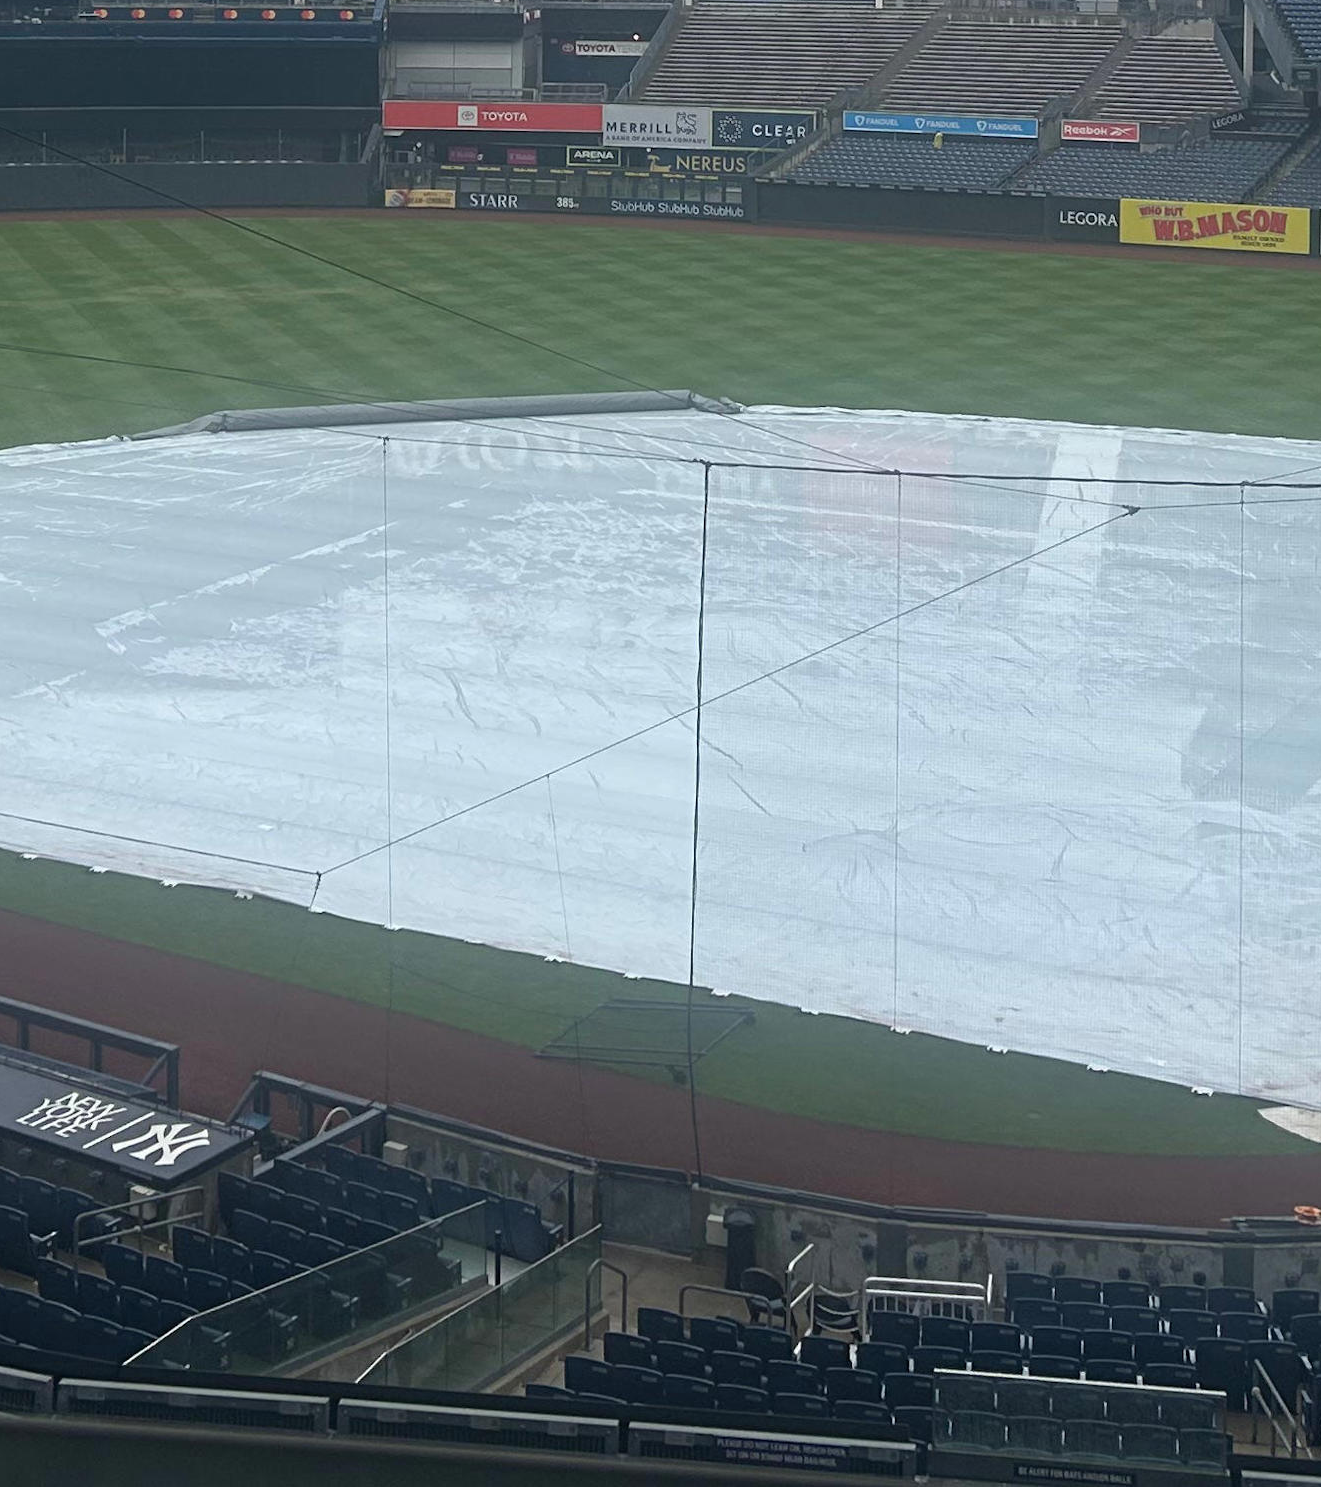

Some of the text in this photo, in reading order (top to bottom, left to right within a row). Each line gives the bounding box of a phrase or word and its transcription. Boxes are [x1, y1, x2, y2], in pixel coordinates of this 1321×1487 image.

[577, 44, 615, 52] TOYOTA
[481, 111, 528, 122] TOYOTA
[865, 117, 899, 126] FANDUEL
[1213, 113, 1245, 129] LEGORA
[606, 121, 672, 134] MERRILL
[927, 120, 960, 129] FANDUEL
[988, 123, 1022, 132] FANDUEL
[1064, 125, 1107, 136] Reebok
[752, 125, 806, 137] CLEAR
[574, 151, 614, 159] ARENA
[676, 155, 746, 172] NEREUS
[470, 193, 518, 208] STARR
[611, 201, 744, 217] StubHub StubHub StubHub
[1139, 206, 1184, 216] WHO BUT
[1059, 211, 1118, 226] LEGORA
[55, 1092, 127, 1114] NEW
[33, 1098, 113, 1131] YORK
[15, 1113, 77, 1138] LIFE
